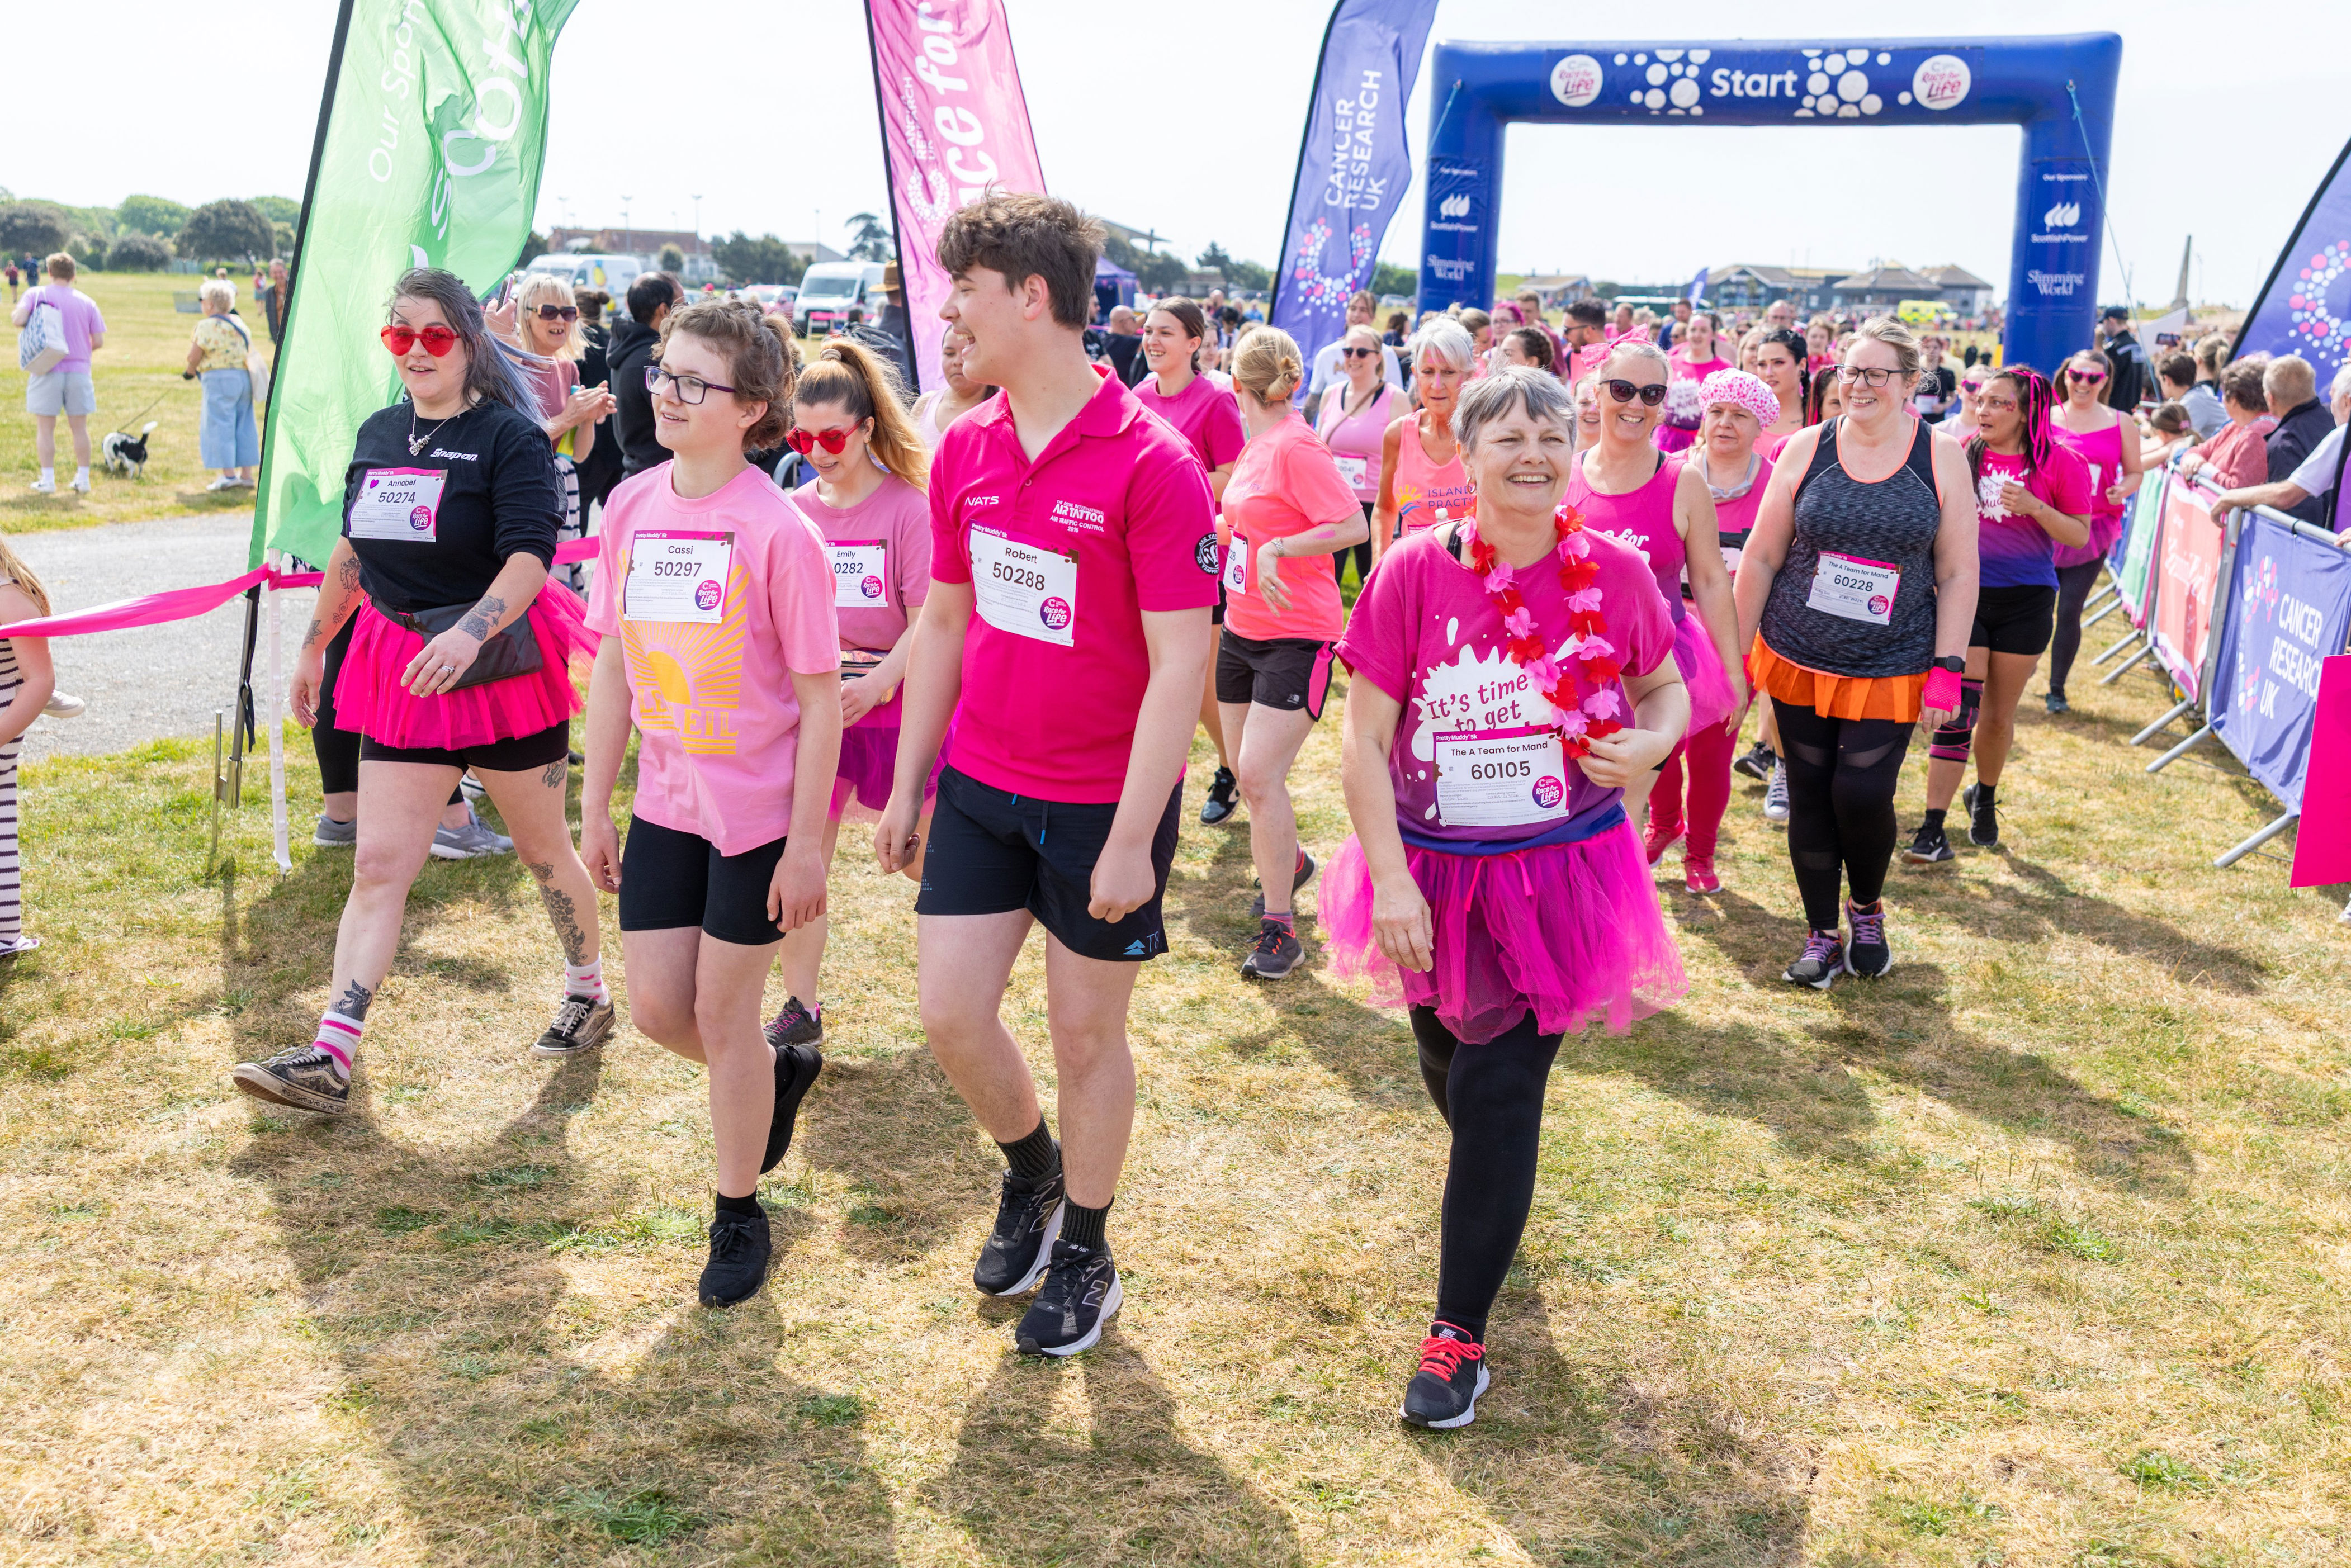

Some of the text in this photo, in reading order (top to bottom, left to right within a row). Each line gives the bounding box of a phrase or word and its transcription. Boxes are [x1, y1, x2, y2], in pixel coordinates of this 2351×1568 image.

[914, 1, 969, 95] for
[1709, 67, 1797, 98] Start
[368, 104, 399, 182] Our
[1344, 69, 1383, 210] RESEARCH
[1323, 97, 1356, 207] CANCER
[1360, 176, 1388, 212] UK
[2030, 233, 2089, 243] ScottishPower
[1427, 254, 1475, 272] Slimming
[1434, 266, 1465, 281] World
[2027, 269, 2085, 286] Slimming
[2037, 281, 2074, 296] World
[377, 492, 416, 504] 50274
[964, 495, 1000, 506] NATS
[414, 517, 429, 526] Life
[1052, 504, 1104, 524] AIR TATTOO
[972, 523, 985, 533] Pretty
[1058, 517, 1078, 527] TRAFFIC
[1078, 522, 1105, 533] CONTROL
[668, 546, 693, 555] Cassi
[836, 551, 856, 559] Emily
[1005, 547, 1038, 564] Robert
[654, 561, 702, 577] 50297
[832, 562, 864, 574] 0282
[1844, 565, 1861, 575] Team
[1871, 570, 1889, 579] Mand
[992, 561, 1045, 591] 50288
[1834, 574, 1874, 592] 60228
[865, 586, 880, 595] Life
[699, 595, 718, 605] Life
[1043, 605, 1058, 614] Race
[1046, 613, 1067, 623] Life
[2279, 593, 2323, 650] CANCER
[1426, 673, 1529, 720] It's time
[2259, 678, 2281, 720] UK
[1455, 699, 1522, 732] to get
[1477, 746, 1505, 755] Team
[1507, 745, 1520, 753] for
[1522, 741, 1548, 752] Mand
[1471, 760, 1531, 780] 60105
[1535, 787, 1550, 795] Race
[1540, 789, 1560, 804] Life
[1441, 1328, 1457, 1338] NIKE
